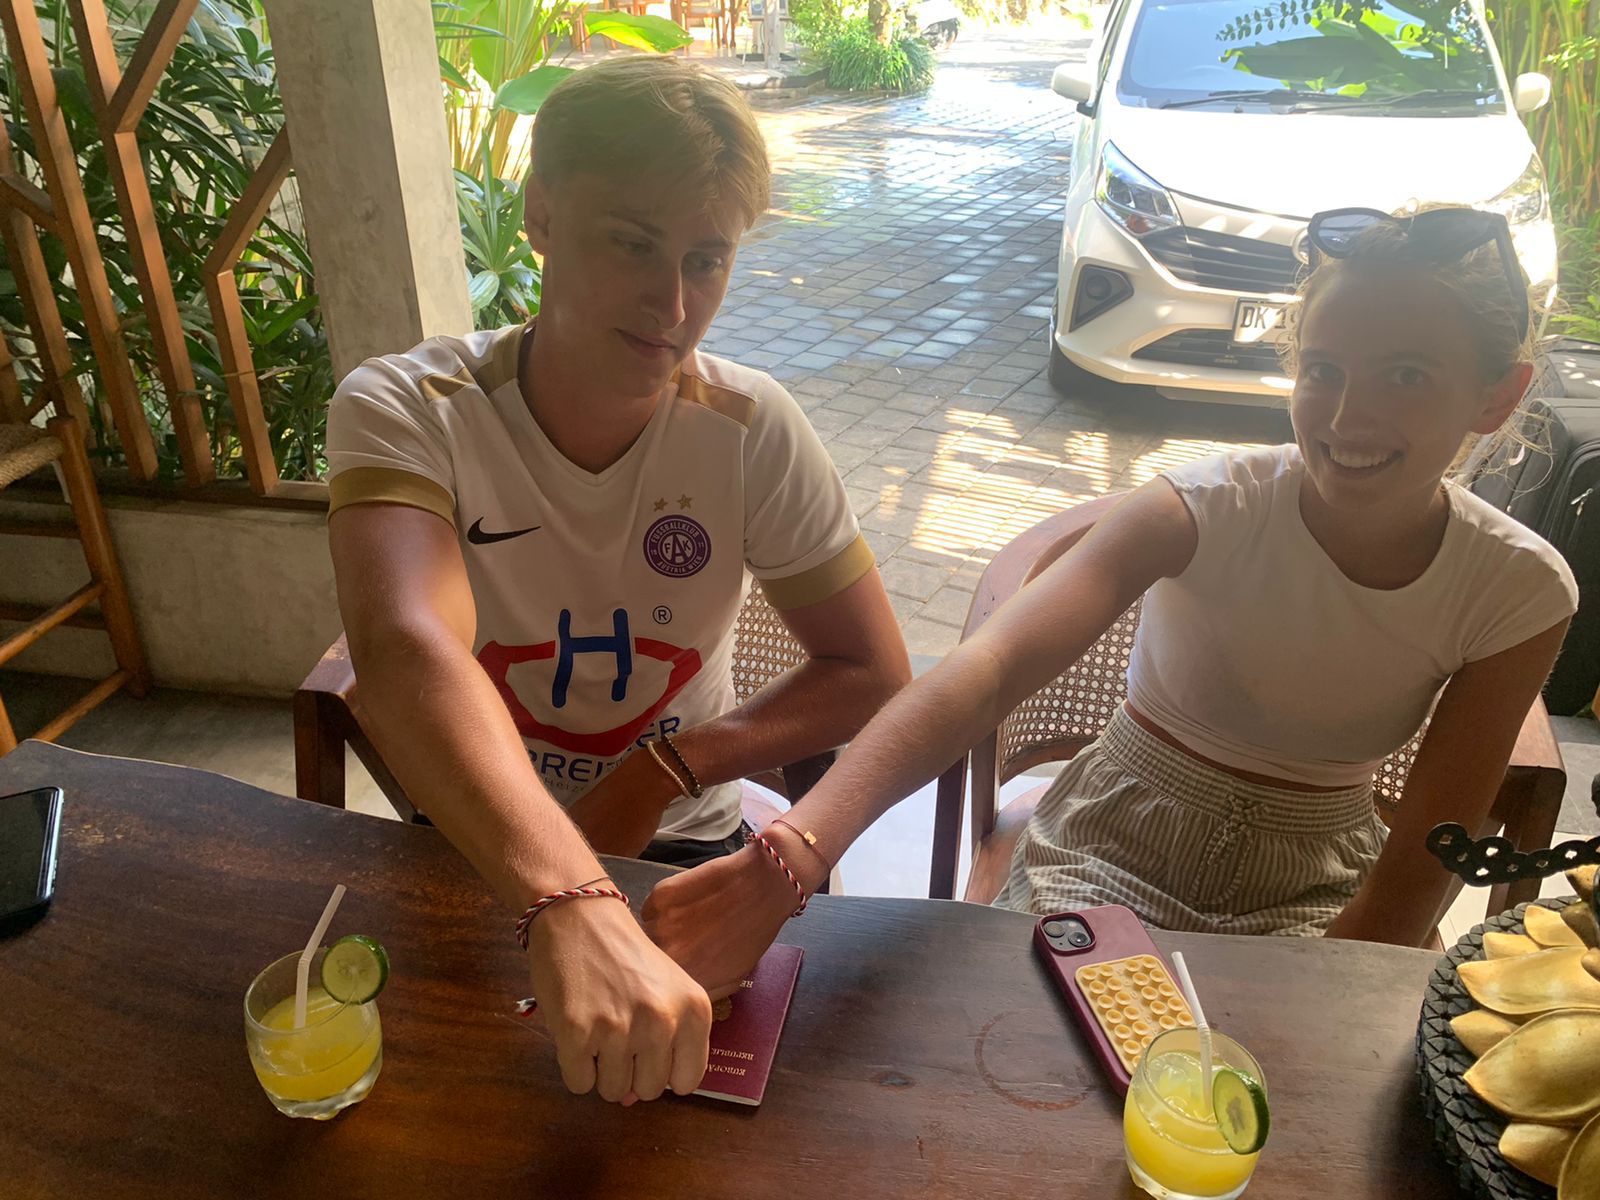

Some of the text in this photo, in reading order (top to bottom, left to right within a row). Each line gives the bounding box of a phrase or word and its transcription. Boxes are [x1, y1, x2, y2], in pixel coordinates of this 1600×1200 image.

[1240, 306, 1269, 330] DK
[650, 521, 700, 544] FUSSBALLKLUB
[656, 555, 703, 574] AUSTRIA WIEN
[552, 608, 633, 709] H
